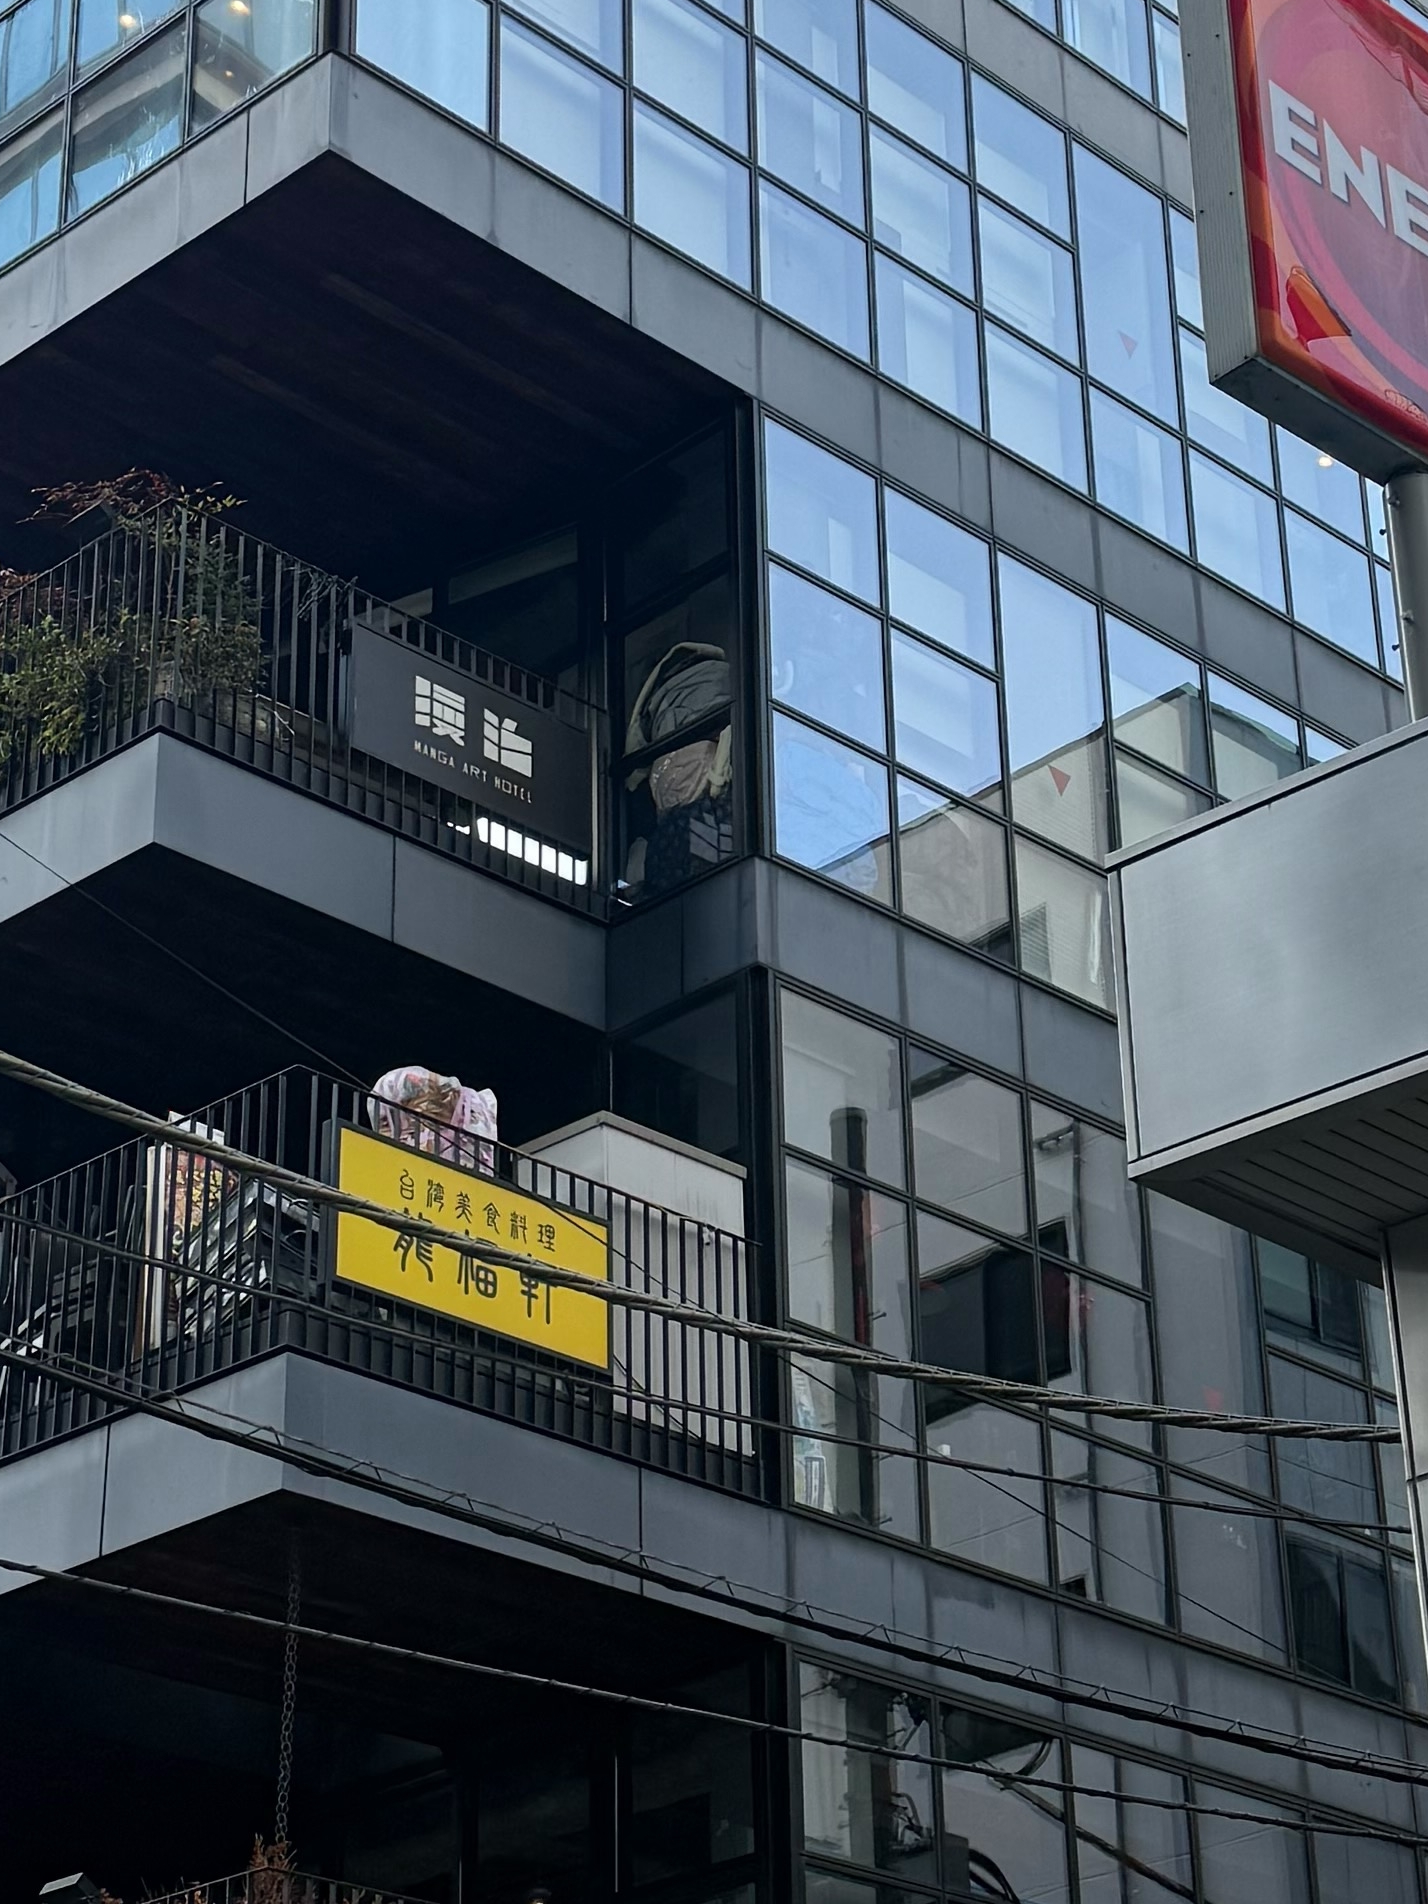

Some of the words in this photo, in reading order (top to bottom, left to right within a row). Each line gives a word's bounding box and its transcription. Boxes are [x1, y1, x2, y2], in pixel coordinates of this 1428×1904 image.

[414, 740, 455, 768] MANGA
[462, 762, 488, 782] ART
[494, 775, 533, 804] HOTEL
[400, 1169, 556, 1254] 台湾美食料理
